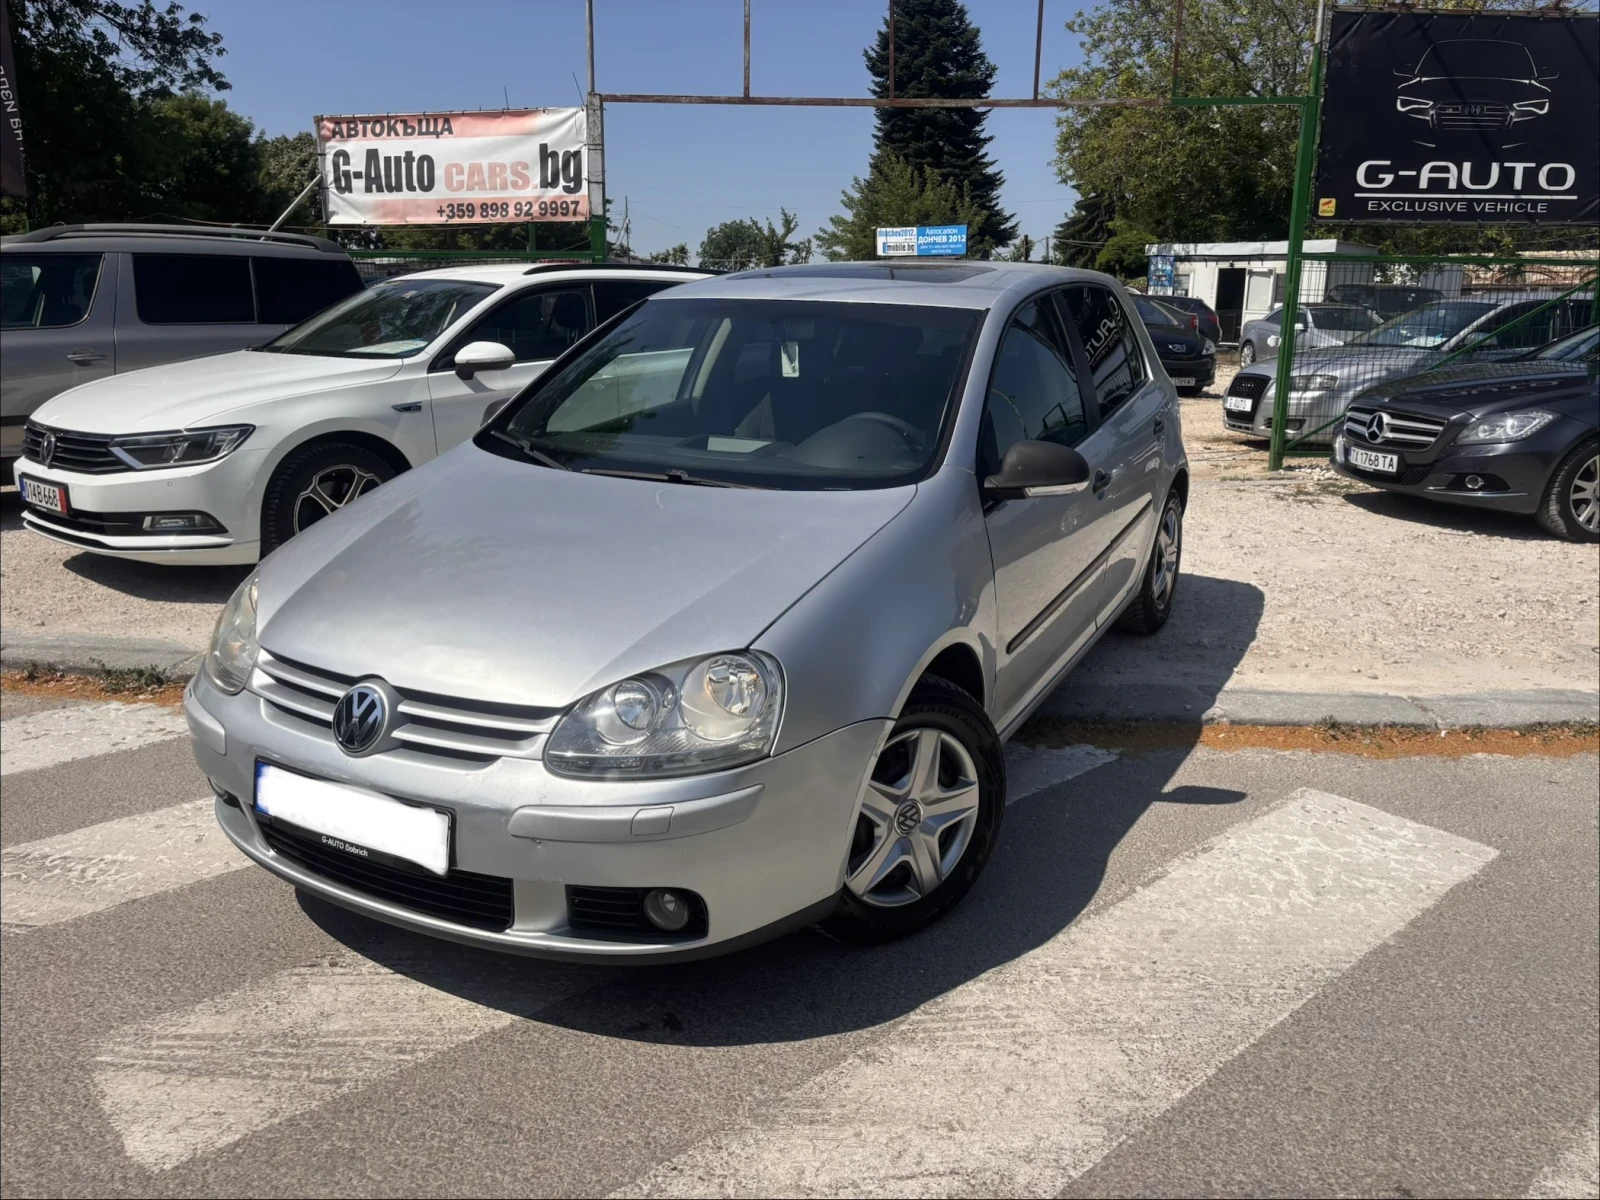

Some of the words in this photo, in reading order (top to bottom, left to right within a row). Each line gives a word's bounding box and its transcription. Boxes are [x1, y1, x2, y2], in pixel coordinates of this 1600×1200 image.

[331, 117, 454, 139] АВТОКЪЩА
[332, 148, 436, 195] G-Auto
[1355, 160, 1576, 191] G-AUTO
[436, 202, 476, 220] +359
[479, 202, 509, 219] 898
[513, 201, 534, 217] 92
[538, 200, 580, 217] 9997
[1367, 200, 1468, 213] EXCLUSIVE
[1472, 201, 1549, 213] VEHICLE
[886, 243, 915, 252] mobile.bg
[918, 235, 948, 245] ДОНЧЕВ
[948, 235, 966, 243] 2012
[1360, 452, 1379, 468] 1768
[1381, 456, 1395, 470] TA
[321, 835, 345, 849] G-AUTO
[345, 843, 369, 857] Dobrich
